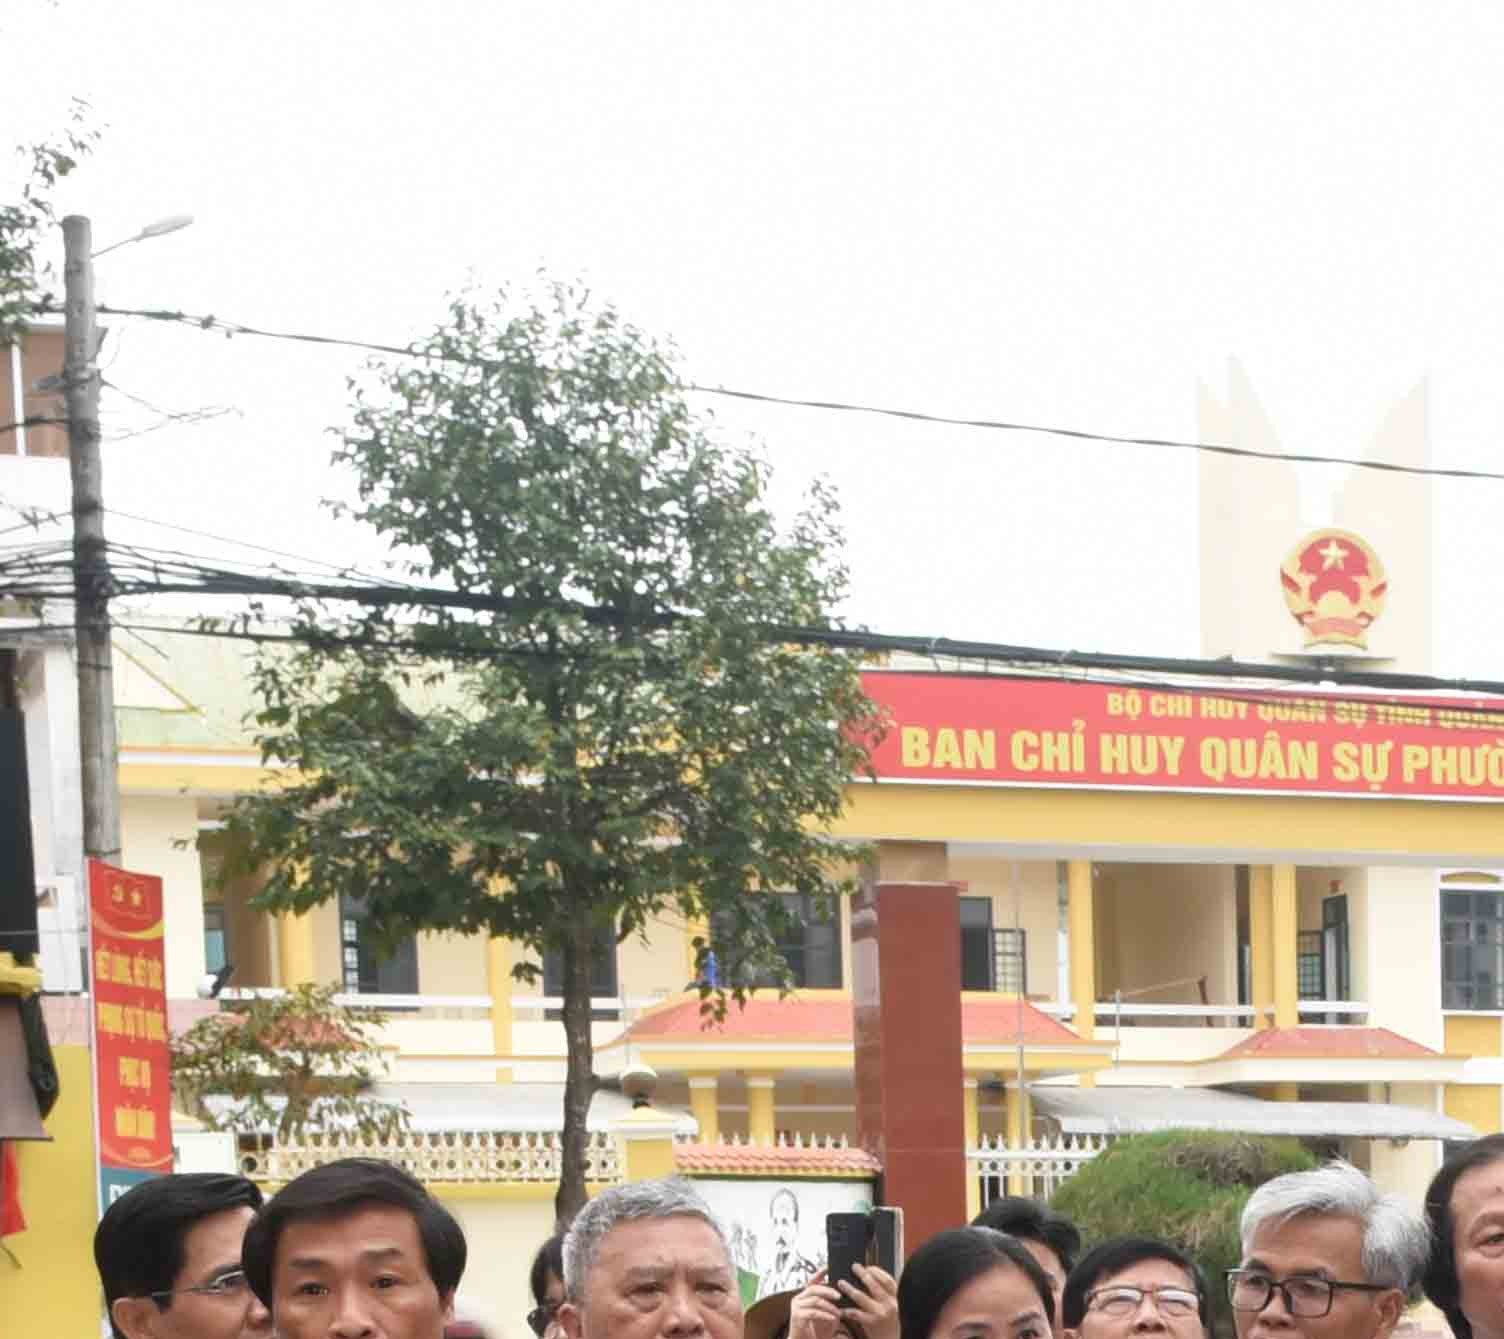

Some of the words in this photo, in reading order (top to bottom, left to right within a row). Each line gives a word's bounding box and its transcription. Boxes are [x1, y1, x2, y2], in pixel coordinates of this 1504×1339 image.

[1106, 688, 1141, 722] BỘ
[1200, 695, 1249, 721] HUY
[900, 725, 997, 770] BAN
[1010, 718, 1087, 773] CHỈ
[1098, 732, 1186, 777] HUY
[1199, 730, 1321, 782] QUÂN
[1332, 740, 1393, 791] SỰ
